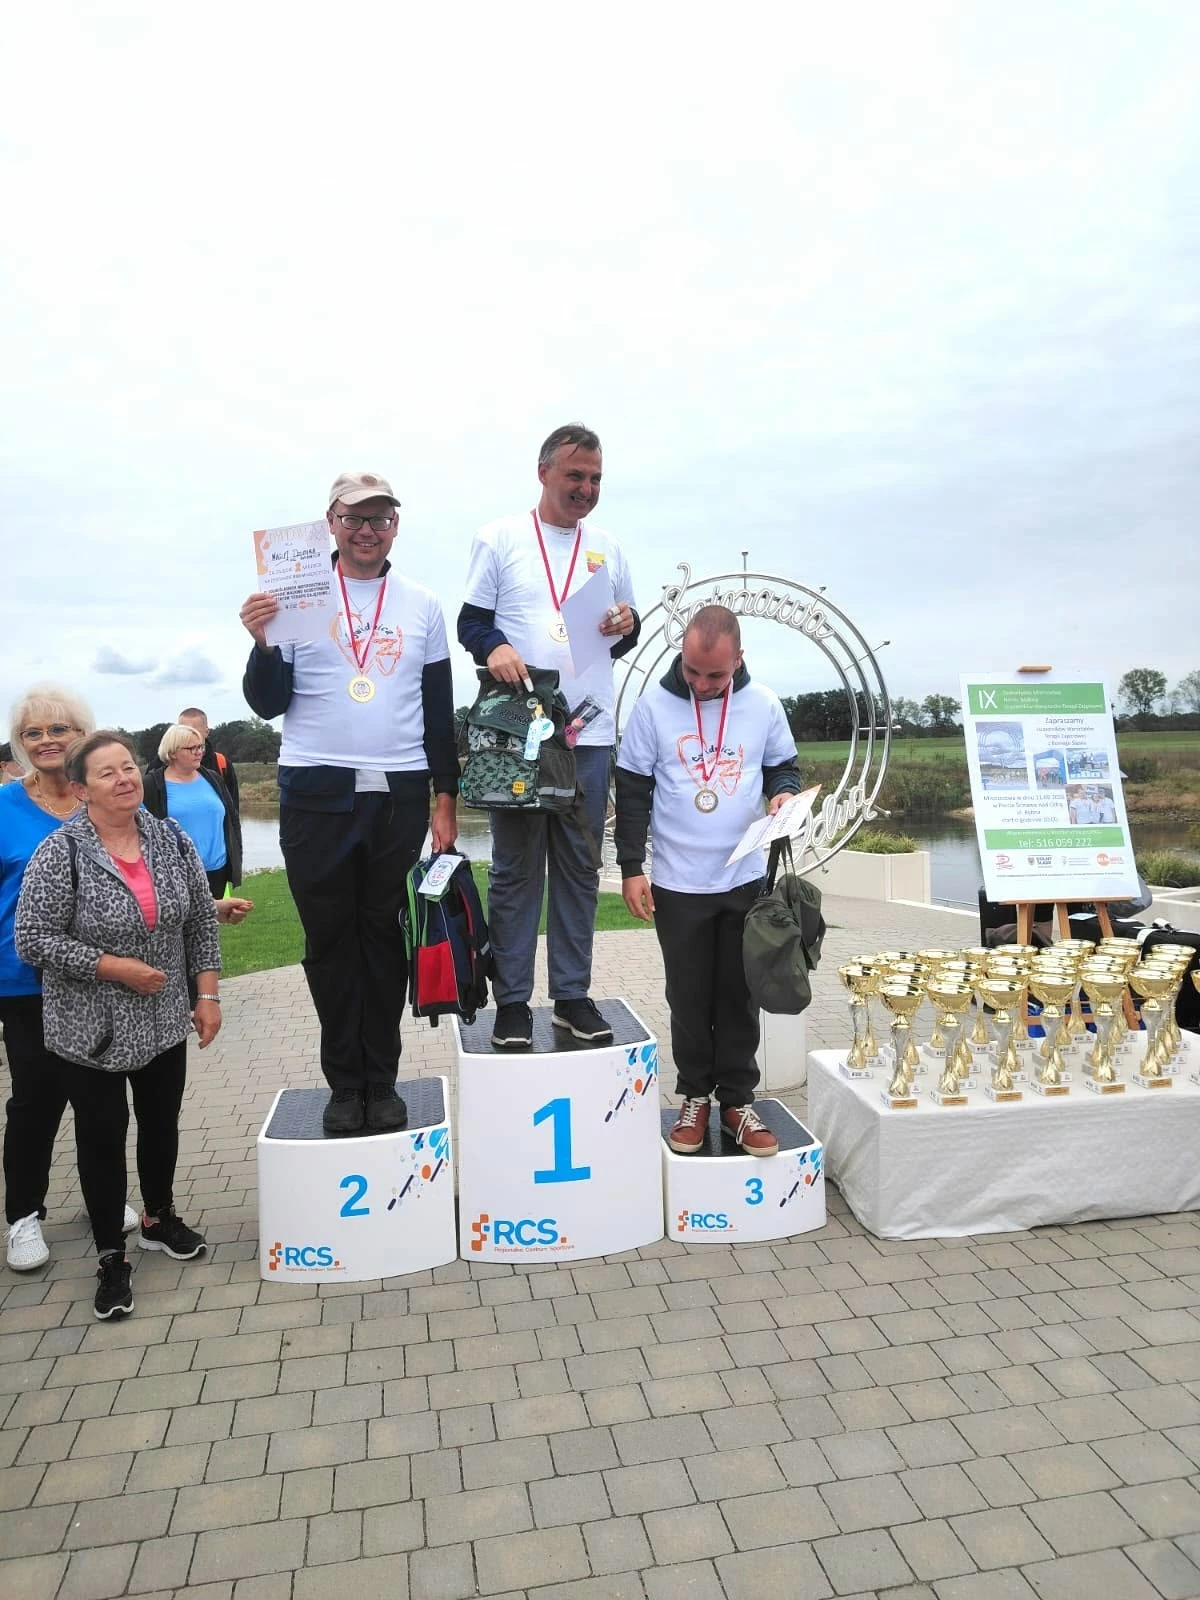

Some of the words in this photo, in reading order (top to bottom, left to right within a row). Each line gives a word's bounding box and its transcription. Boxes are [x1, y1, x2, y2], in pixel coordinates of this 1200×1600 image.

[978, 689, 998, 709] IX
[1036, 839, 1054, 848] 516
[533, 1097, 591, 1184] 1
[339, 1174, 370, 1218] 2
[745, 1178, 764, 1205] 3
